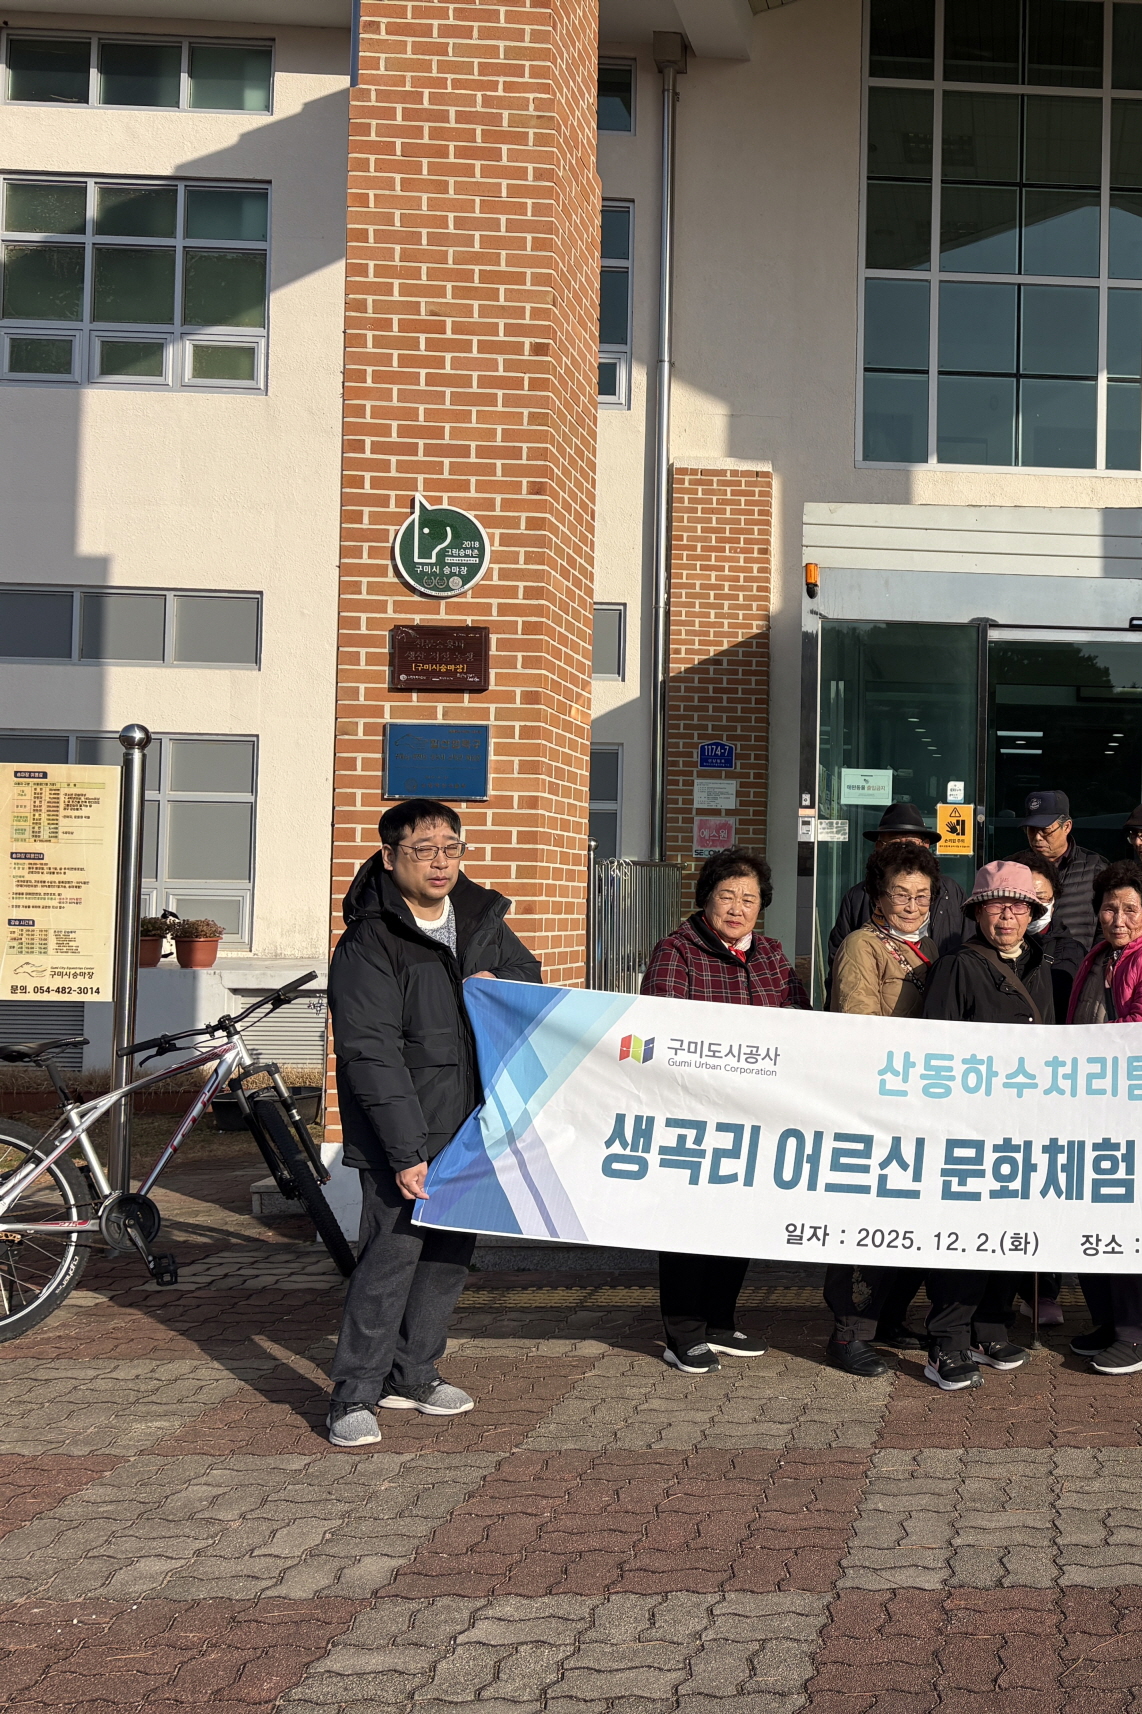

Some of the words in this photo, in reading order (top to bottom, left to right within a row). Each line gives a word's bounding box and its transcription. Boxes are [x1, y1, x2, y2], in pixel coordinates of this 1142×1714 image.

[462, 540, 480, 548] 2018
[414, 564, 440, 575] 구미시
[442, 565, 468, 575] 승마장
[704, 744, 731, 757] 1174-7
[699, 828, 729, 841] 에스원
[49, 970, 95, 980] 구미시승마장
[10, 984, 31, 995] 문의.
[33, 985, 101, 996] 054-482-3014
[667, 1037, 781, 1067] 구미도시공사
[667, 1057, 692, 1069] Gumi
[694, 1059, 723, 1072] Urban
[724, 1062, 778, 1078] Corporation
[601, 1112, 762, 1189] 생곡리
[772, 1127, 926, 1201] 어르신
[940, 1136, 1136, 1205] 문화체험
[784, 1223, 830, 1248] 일자
[856, 1227, 922, 1252] 2025.
[933, 1230, 967, 1253] 12.
[975, 1231, 1040, 1256] 2.(화)
[1080, 1232, 1125, 1257] 장소
